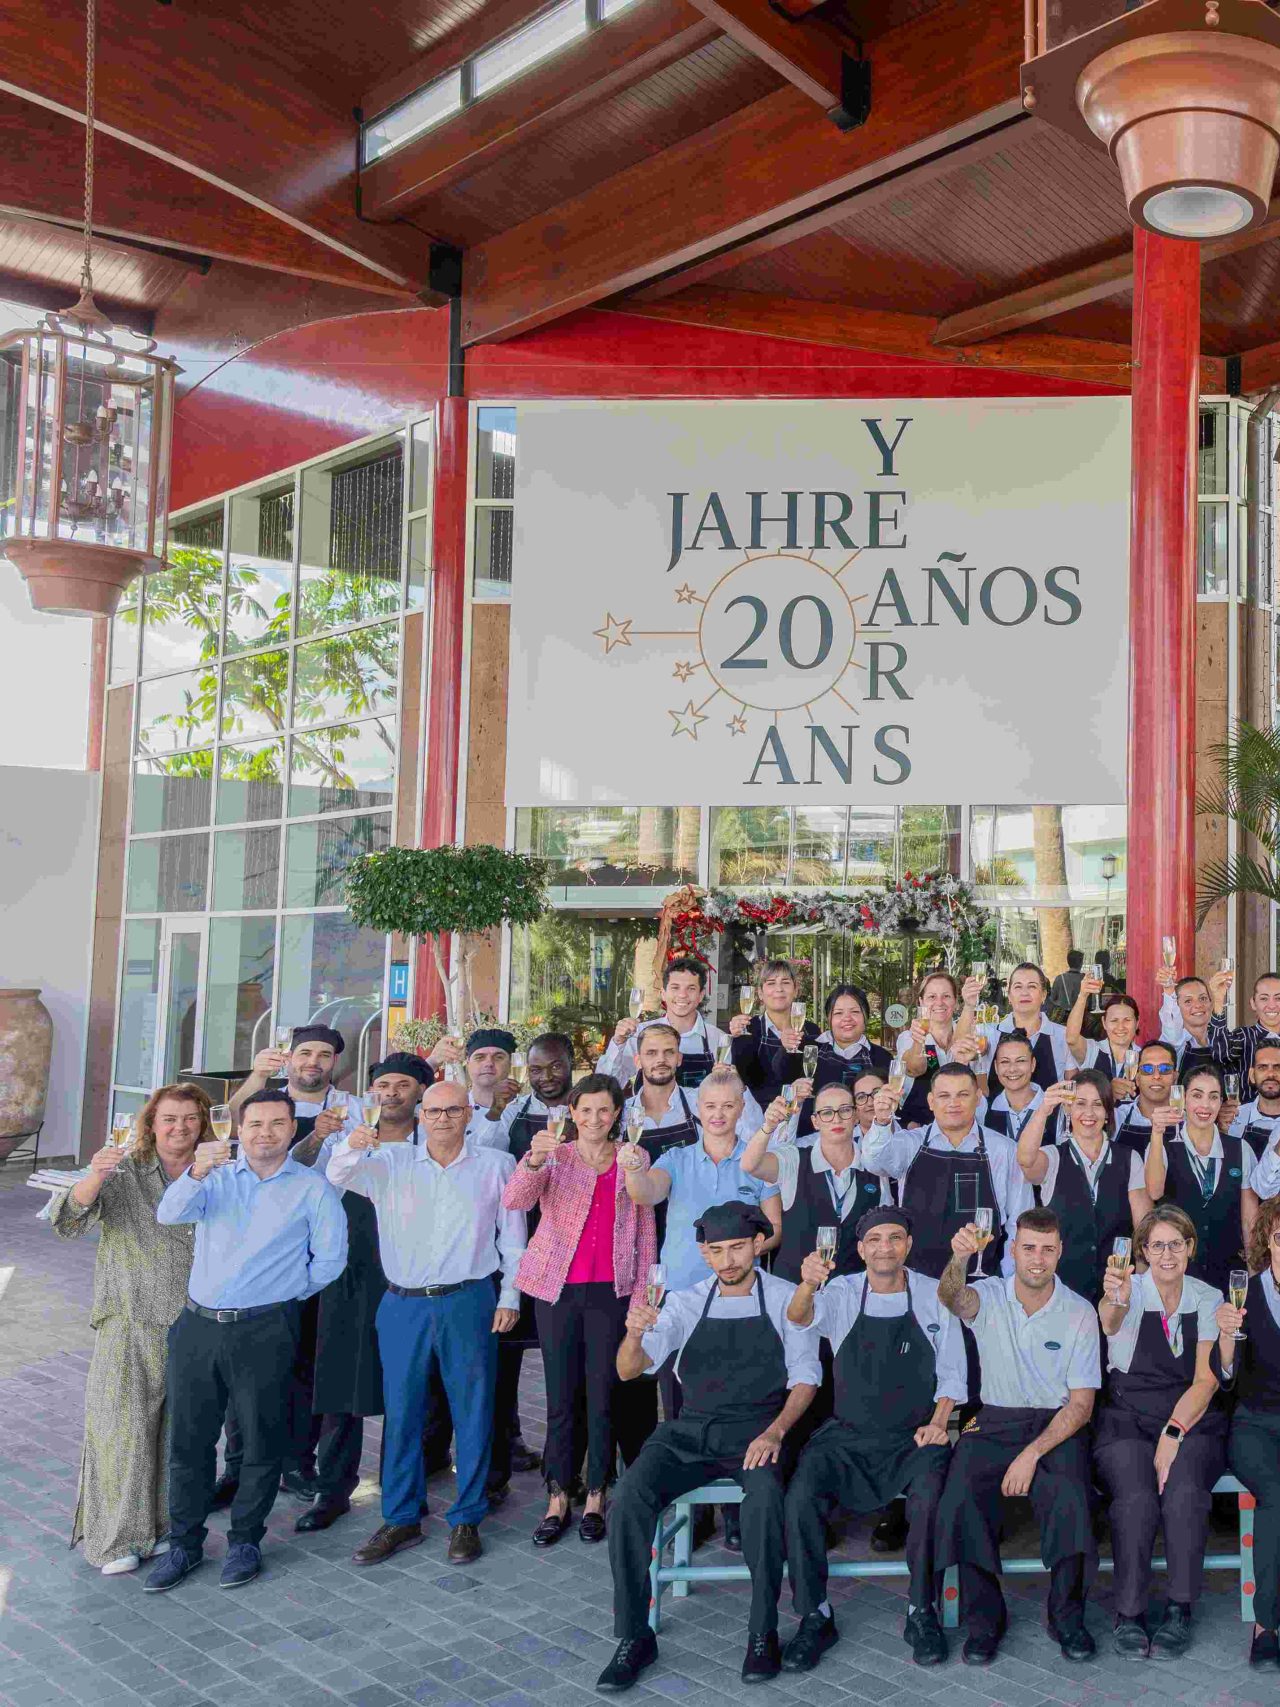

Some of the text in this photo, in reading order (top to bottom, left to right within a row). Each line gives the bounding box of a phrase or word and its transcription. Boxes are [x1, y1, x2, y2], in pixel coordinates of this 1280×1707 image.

[667, 491, 907, 573] JAHRE
[861, 551, 1082, 627] AÑOS
[720, 594, 834, 670] 20
[743, 724, 912, 786] ANS
[394, 970, 405, 995] H
